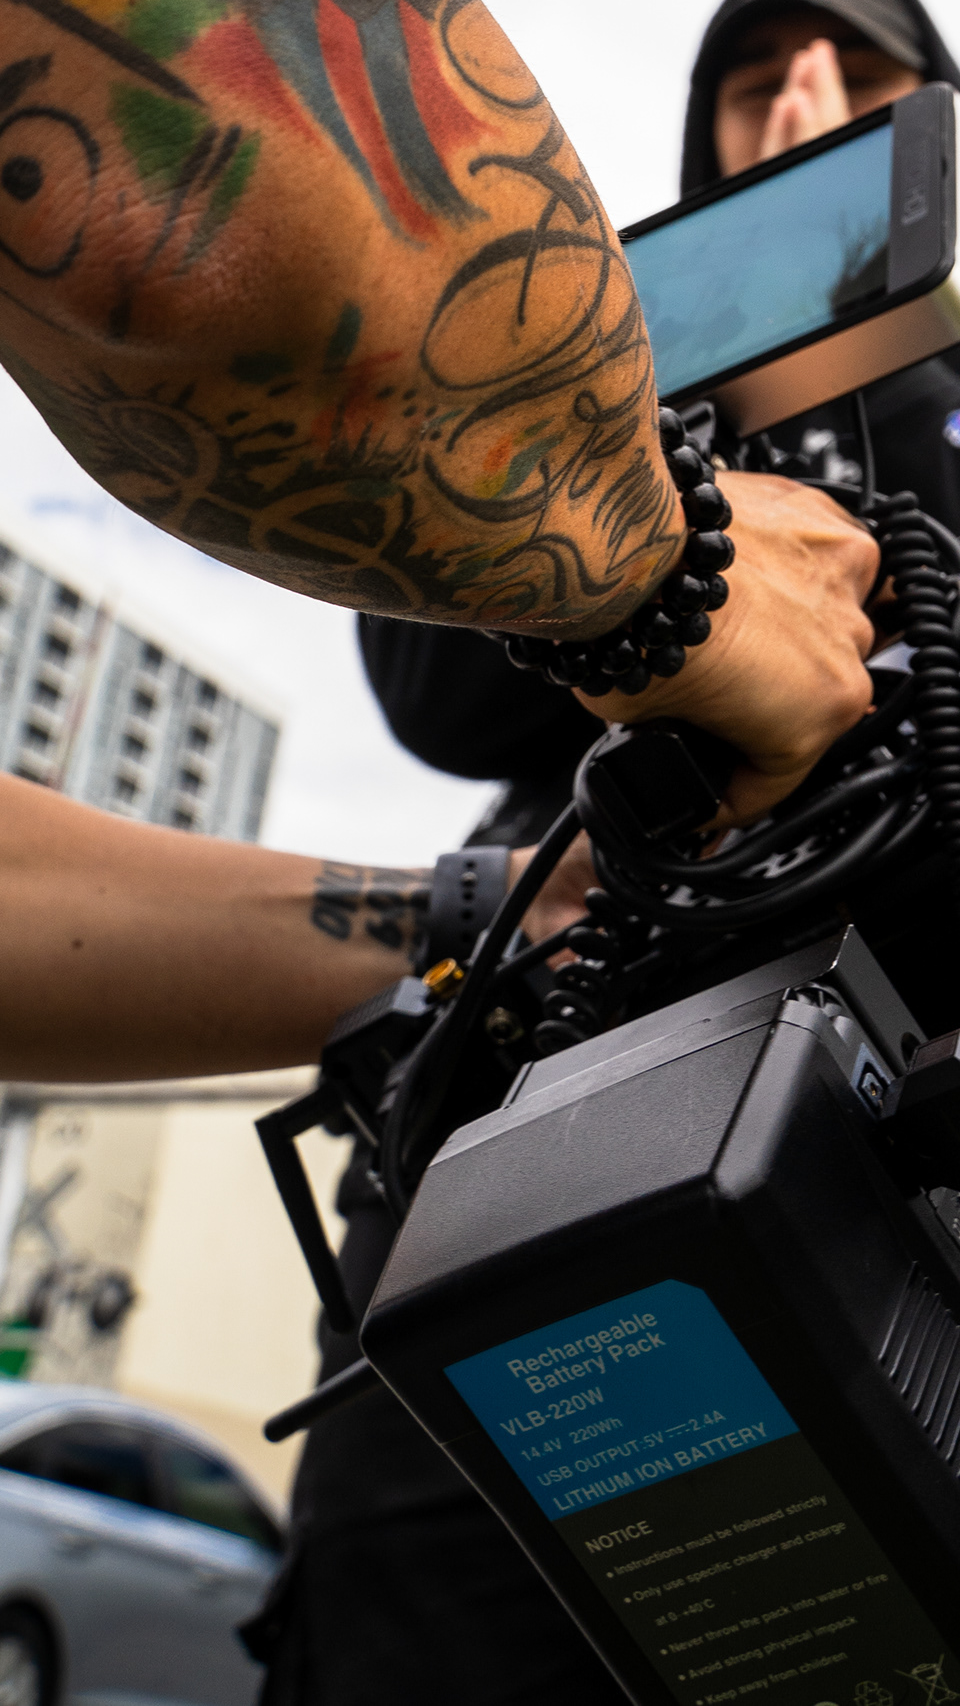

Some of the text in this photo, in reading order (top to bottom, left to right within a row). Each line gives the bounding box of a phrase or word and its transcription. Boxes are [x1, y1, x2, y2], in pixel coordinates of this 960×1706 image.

[508, 1312, 657, 1378] Rechargeable
[525, 1330, 667, 1394] Battery Pack
[500, 1387, 603, 1435] VLB-220W
[521, 1416, 623, 1461] 14.4V 220Wh
[536, 1465, 573, 1486] USB
[553, 1422, 766, 1511] LITHIUM ION BATTERY
[584, 1520, 654, 1553] NOTICE
[613, 1495, 827, 1575] Instructions must be followed strictly
[632, 1522, 846, 1601] Only use specific charger and charge
[668, 1573, 889, 1653] Never throw the pack into water or fire
[688, 1660, 723, 1679] Avoid
[723, 1648, 764, 1667] strong
[763, 1629, 813, 1655] physical
[704, 1652, 848, 1704] Keep away from children
